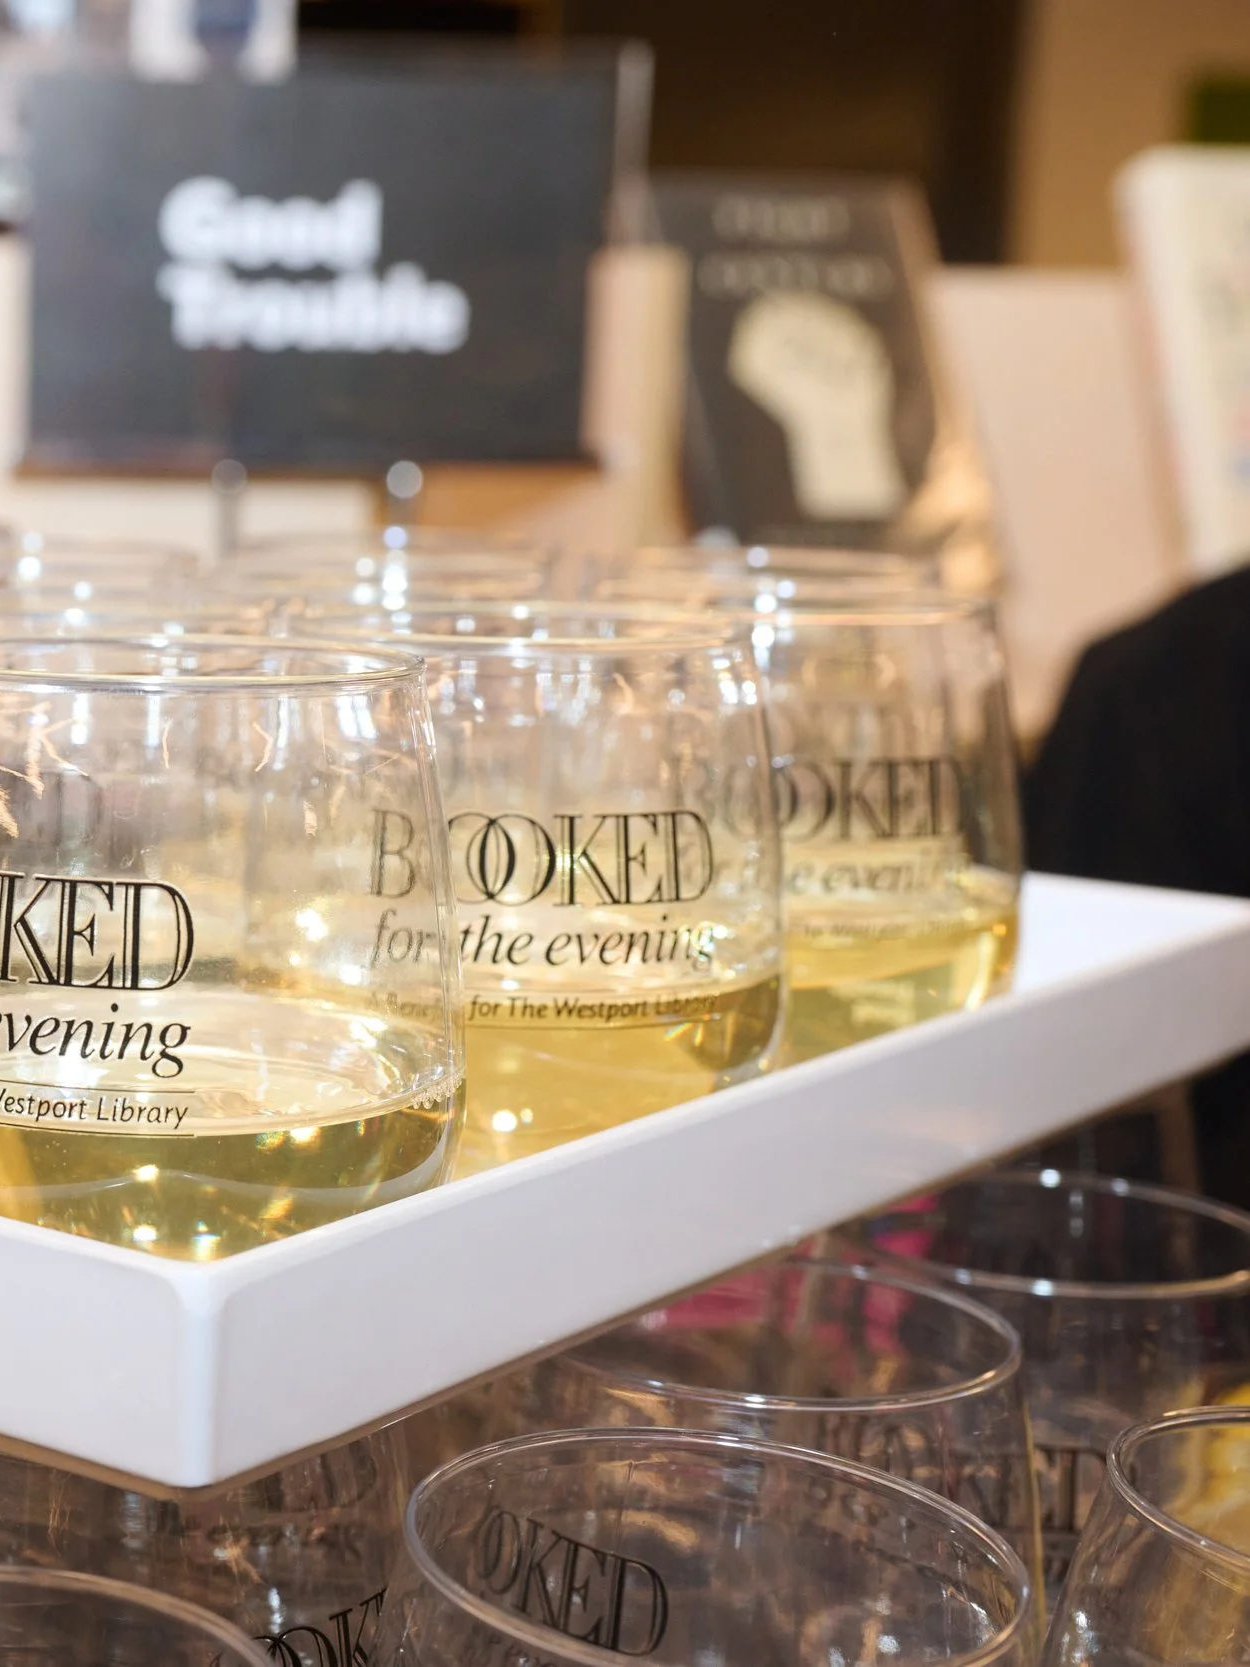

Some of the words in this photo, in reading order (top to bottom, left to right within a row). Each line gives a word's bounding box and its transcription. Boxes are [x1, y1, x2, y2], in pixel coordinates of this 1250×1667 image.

[158, 177, 382, 269] Good
[156, 263, 470, 353] Trouble
[369, 908, 437, 973] for
[460, 914, 534, 967] the
[545, 914, 716, 973] evening
[468, 994, 502, 1021] for
[507, 995, 549, 1019] The
[553, 998, 648, 1024] Westport
[96, 1090, 189, 1130] Library
